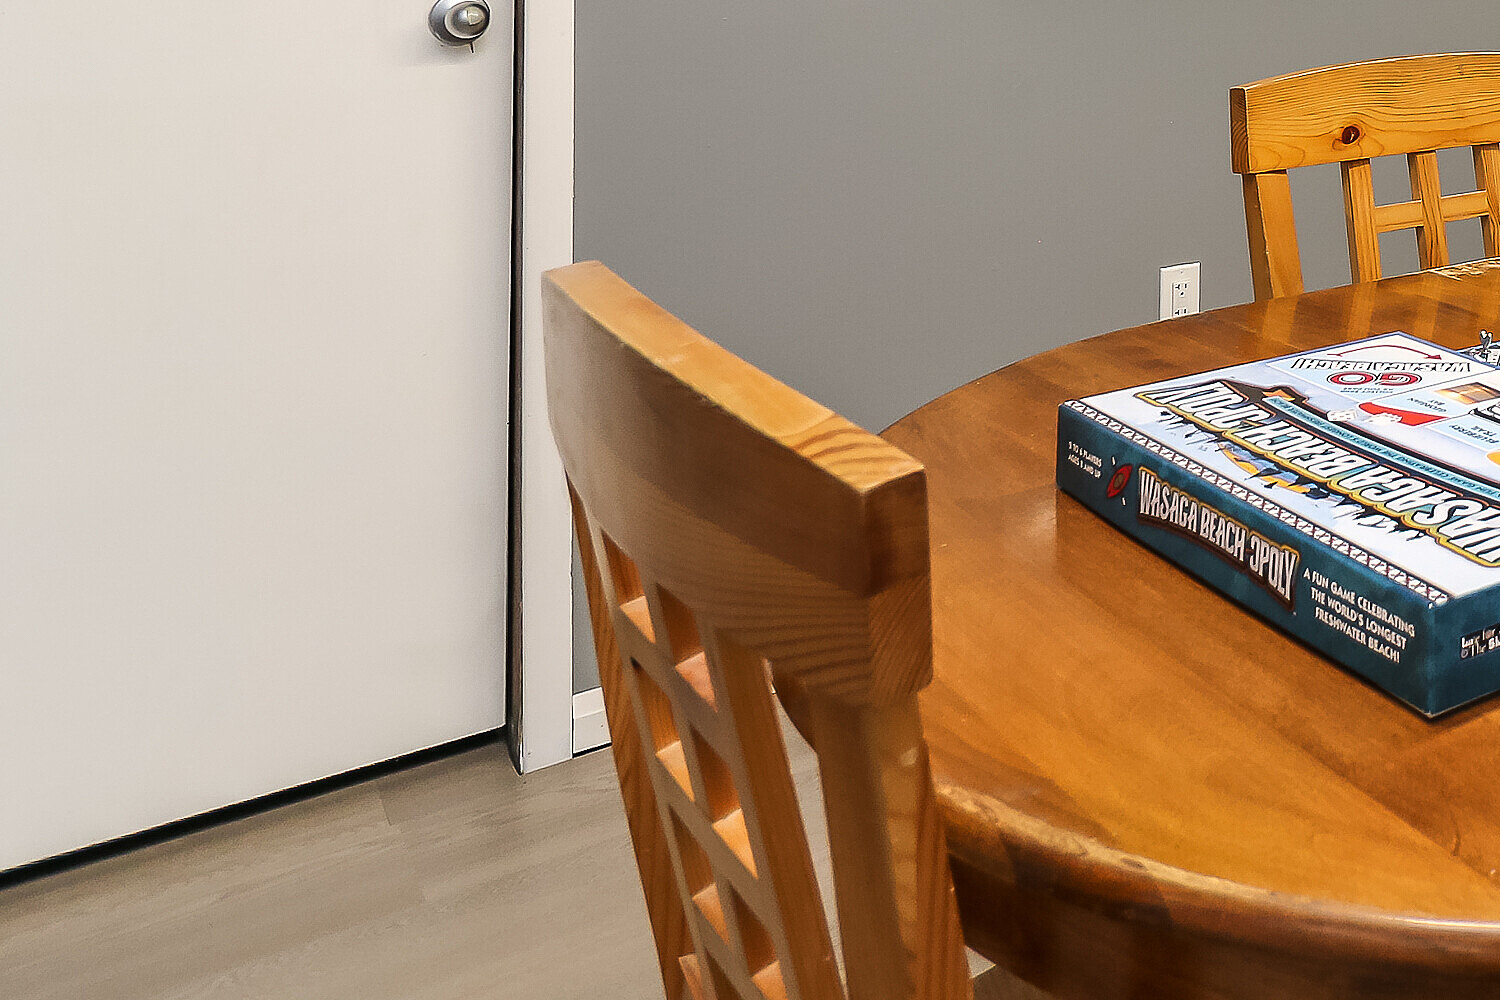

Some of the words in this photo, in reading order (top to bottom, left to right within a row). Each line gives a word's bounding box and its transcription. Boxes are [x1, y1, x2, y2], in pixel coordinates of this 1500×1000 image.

[1290, 358, 1374, 371] BEACH!
[1327, 371, 1422, 387] GO
[1374, 362, 1471, 373] WASAGA
[1238, 420, 1376, 478] BEACH
[1138, 470, 1199, 533] WASAGA
[1199, 506, 1246, 562] BEACH
[1303, 568, 1311, 580] A
[1312, 570, 1329, 588] FUN
[1331, 582, 1356, 604] GAME
[1357, 595, 1416, 638] CELEBRATING
[1310, 586, 1326, 606] THE
[1327, 594, 1364, 626] WORLD'S
[1365, 616, 1408, 651] LONGEST
[1315, 606, 1367, 646] FRESHWATER
[1368, 635, 1400, 664] BEACH!
